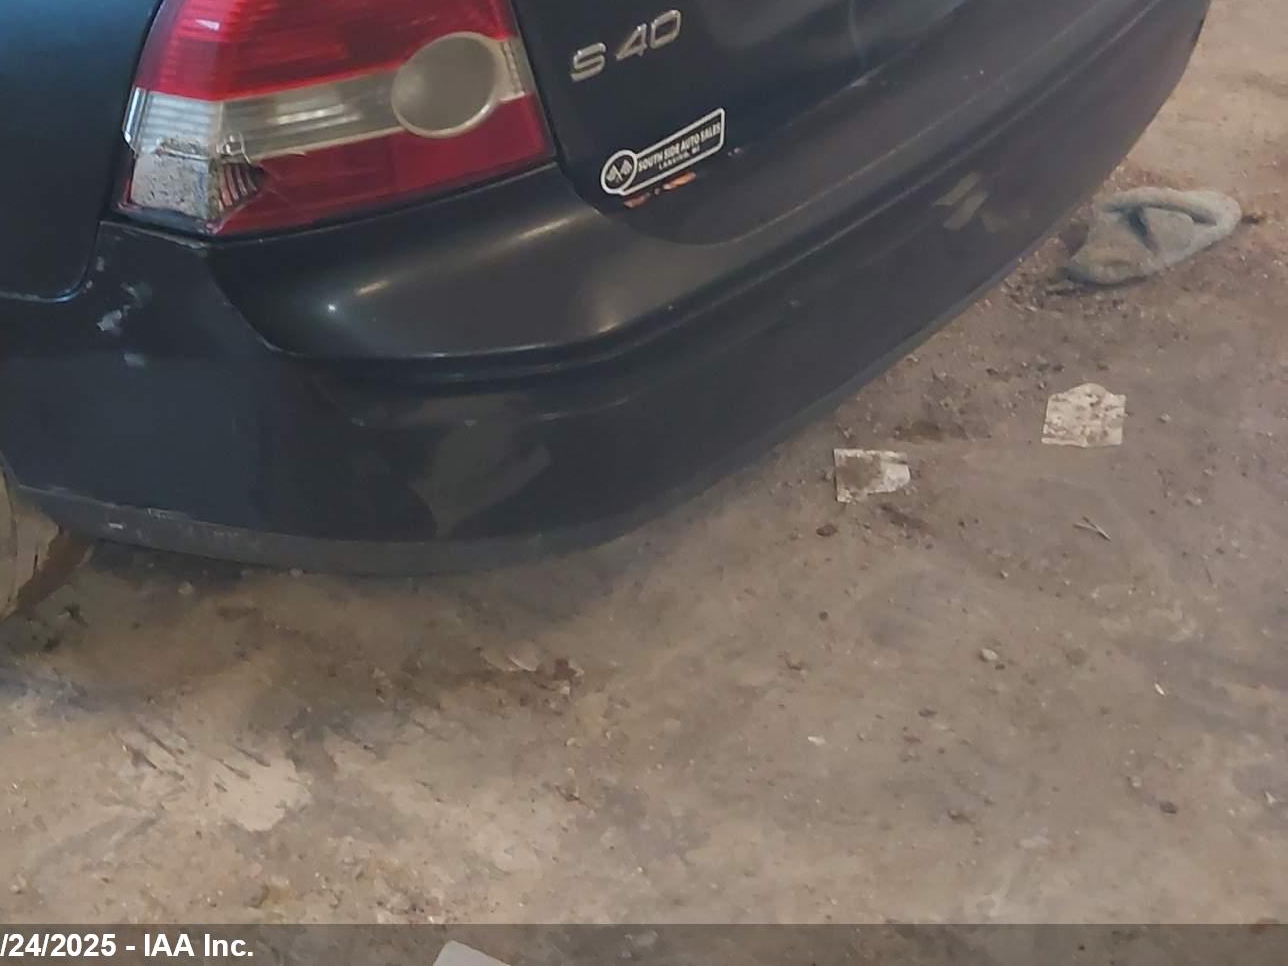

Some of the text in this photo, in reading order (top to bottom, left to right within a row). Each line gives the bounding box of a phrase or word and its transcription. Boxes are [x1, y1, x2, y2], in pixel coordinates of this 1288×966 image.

[638, 122, 721, 172] SOUTH SIDE AUTO SALES
